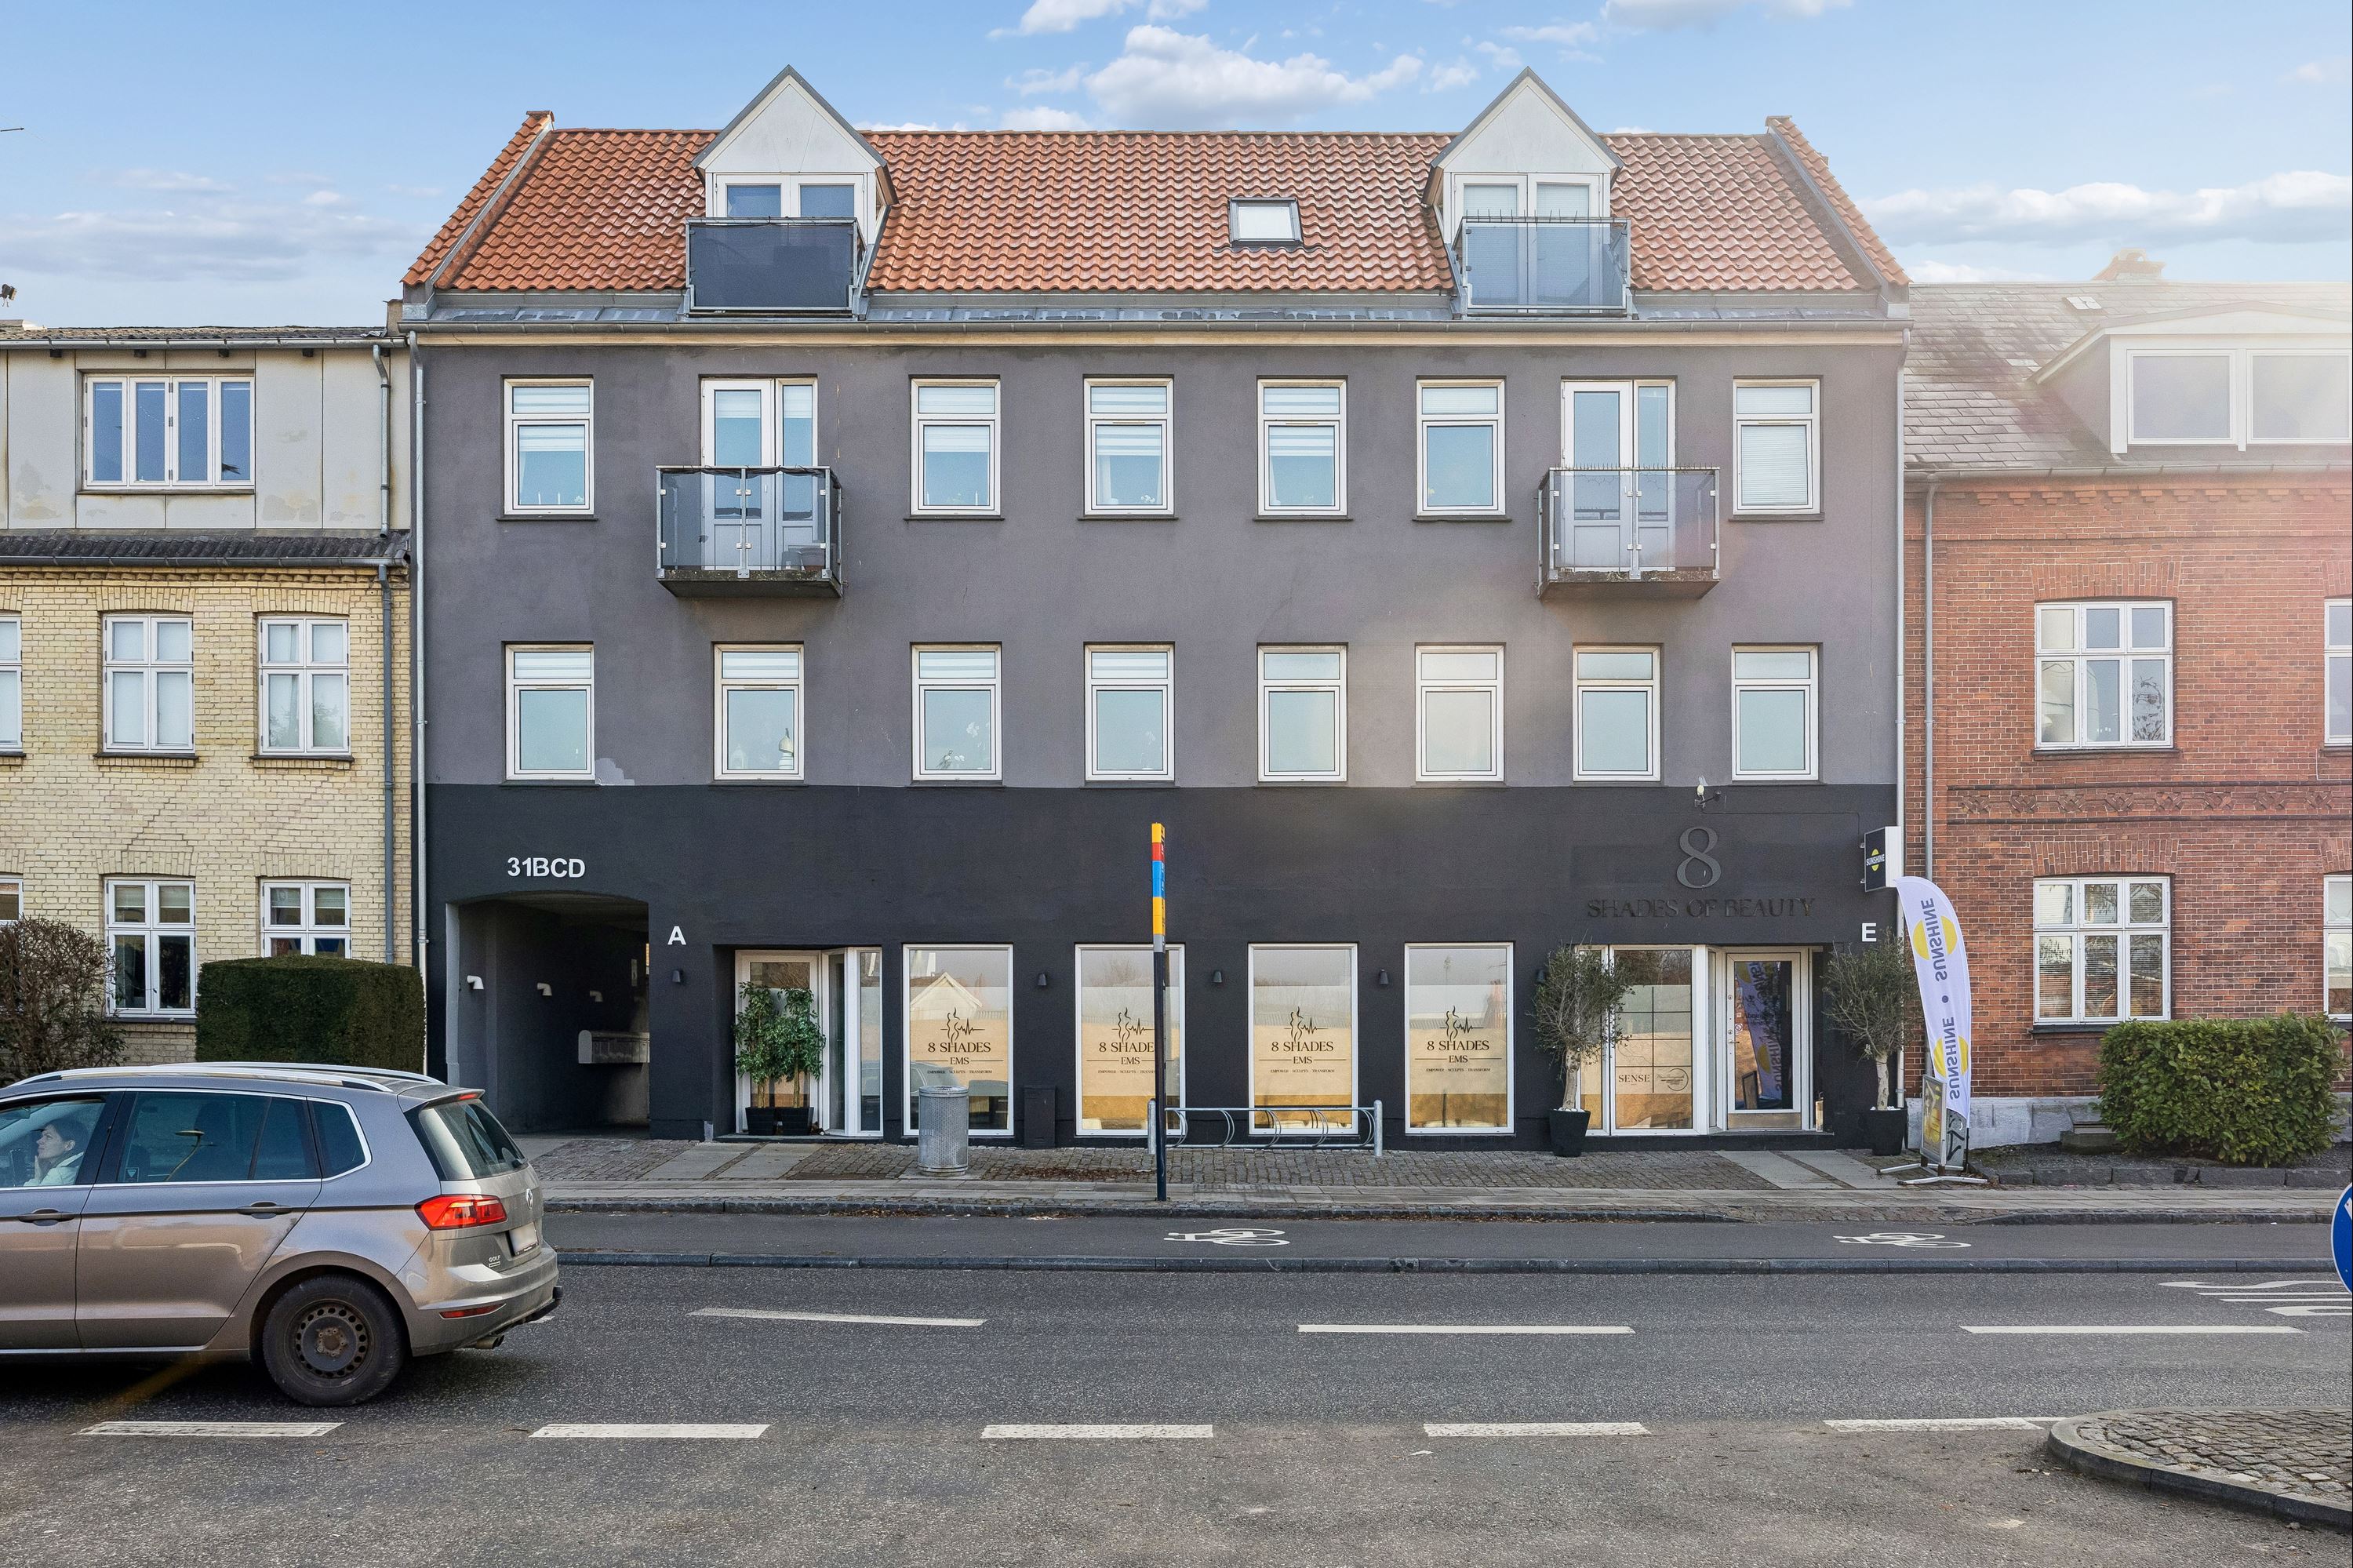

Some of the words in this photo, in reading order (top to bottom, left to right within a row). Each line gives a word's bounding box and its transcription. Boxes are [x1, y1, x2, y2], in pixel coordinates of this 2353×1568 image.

[1676, 827, 1722, 889] 8
[507, 857, 586, 878] 31BCD
[1587, 900, 1678, 918] SHADES
[1687, 898, 1718, 918] OF
[1725, 898, 1815, 918] BEAUTY
[667, 926, 687, 945] A
[1861, 922, 1877, 942] E
[928, 1042, 936, 1053] 8
[940, 1042, 991, 1053] SHADES
[1099, 1042, 1107, 1053] 8
[1111, 1042, 1155, 1053] SHADE
[1271, 1041, 1279, 1052] 8
[1283, 1041, 1334, 1052] SHADES
[1427, 1040, 1435, 1051] 8
[1438, 1040, 1489, 1051] SHADES
[950, 1057, 969, 1065] EMS
[1121, 1057, 1140, 1065] EMS
[1293, 1056, 1313, 1064] EMS
[1449, 1054, 1468, 1063] EMS
[1618, 1074, 1650, 1082] SENSE
